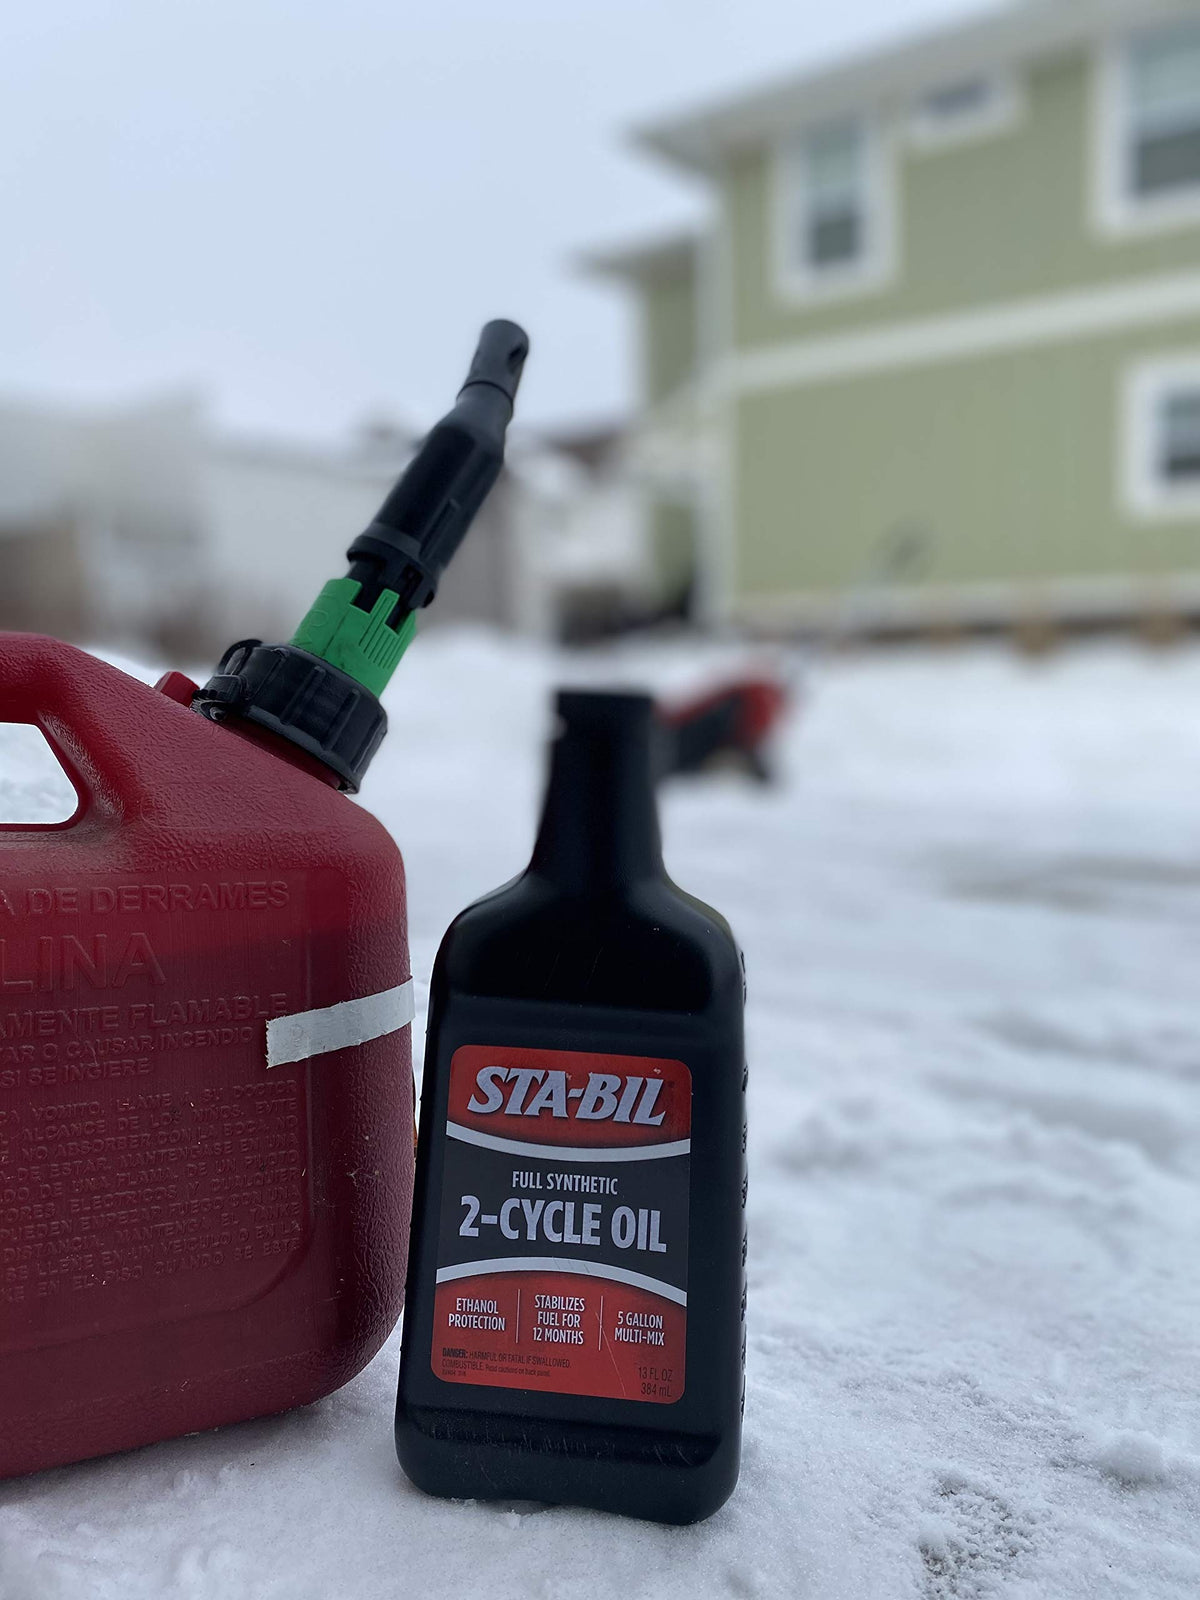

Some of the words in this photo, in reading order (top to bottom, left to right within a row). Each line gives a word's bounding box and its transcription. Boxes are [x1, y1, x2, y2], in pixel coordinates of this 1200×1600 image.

[26, 887, 79, 916] DE
[90, 881, 291, 915] DERRAMES
[0, 932, 167, 993] LINA
[130, 992, 287, 1030] FLAMABLE
[42, 1042, 58, 1061] O
[66, 1035, 155, 1060] CAUSAR
[160, 1026, 254, 1050] INCENDIO
[27, 1066, 57, 1086] SE
[63, 1057, 152, 1084] INGIERE
[467, 1066, 666, 1126] STA-BIL
[512, 1171, 542, 1190] FULL
[546, 1173, 618, 1195] SYNTHETIC
[459, 1195, 601, 1246] 2-CYCLE
[611, 1205, 667, 1253] OIL
[456, 1297, 499, 1314] ETHANOL
[535, 1294, 585, 1311] STABILIZES
[448, 1315, 505, 1331] PROTECTION
[537, 1311, 559, 1326] FUEL
[562, 1312, 580, 1328] FOR
[618, 1311, 624, 1325] 5
[626, 1312, 663, 1330] GALLON
[533, 1327, 542, 1341] 12
[545, 1329, 584, 1345] MONTHS
[614, 1327, 666, 1346] MULTI-MIX
[470, 1351, 498, 1363] HARMFUL
[498, 1353, 507, 1363] OR
[507, 1354, 525, 1364] FATAL
[532, 1355, 572, 1369] SWALLOWED.
[638, 1366, 648, 1379] 13
[650, 1368, 659, 1381] FL
[661, 1369, 673, 1382] OZ
[641, 1383, 657, 1396] 384
[659, 1385, 672, 1398] mL
